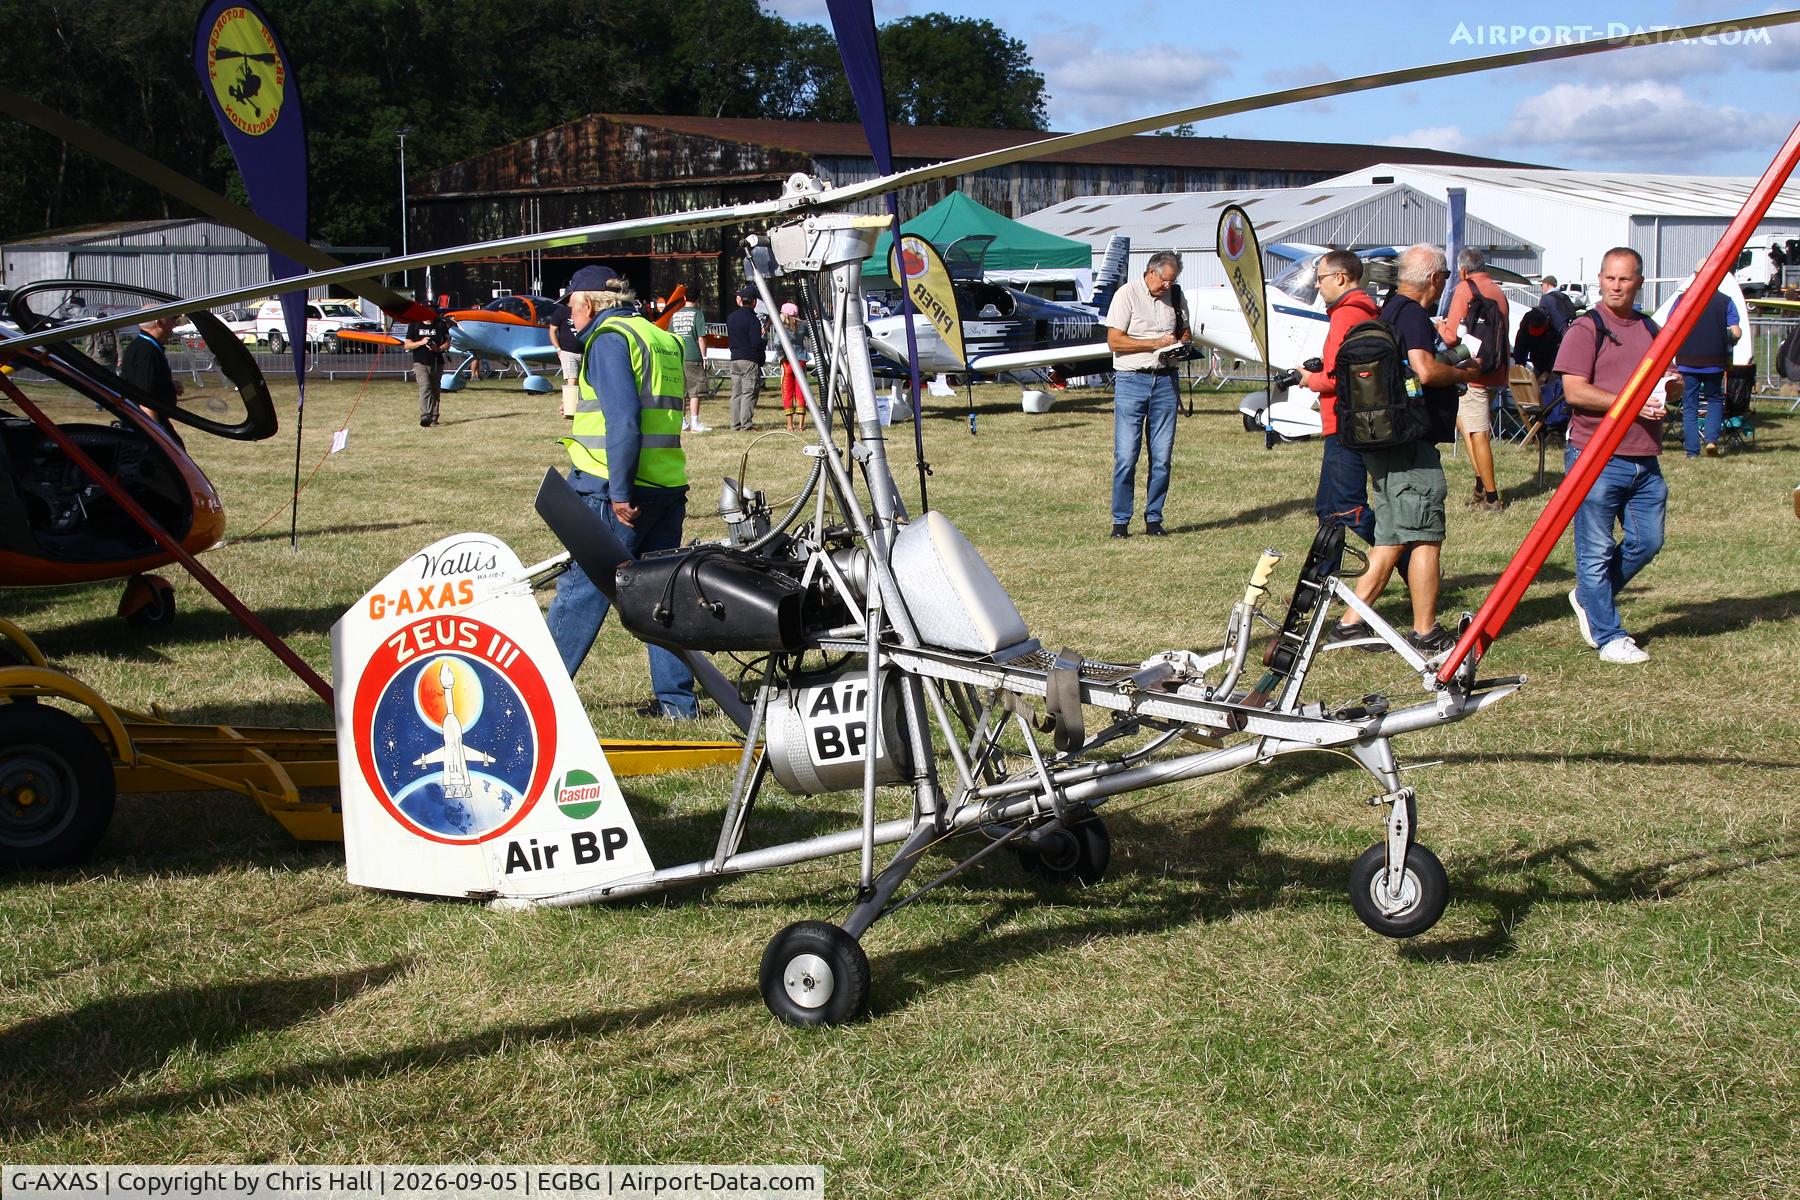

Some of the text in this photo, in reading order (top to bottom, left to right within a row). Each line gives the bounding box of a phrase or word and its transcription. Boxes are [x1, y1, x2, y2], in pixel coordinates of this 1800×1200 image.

[1052, 316, 1092, 341] G-MBMM
[411, 541, 500, 579] Wallis
[369, 579, 474, 620] G-AXAS
[387, 619, 521, 669] ZEUS III
[808, 684, 868, 718] Air
[814, 721, 866, 760] BP
[559, 785, 601, 803] Castrol
[504, 826, 629, 875] Air BP
